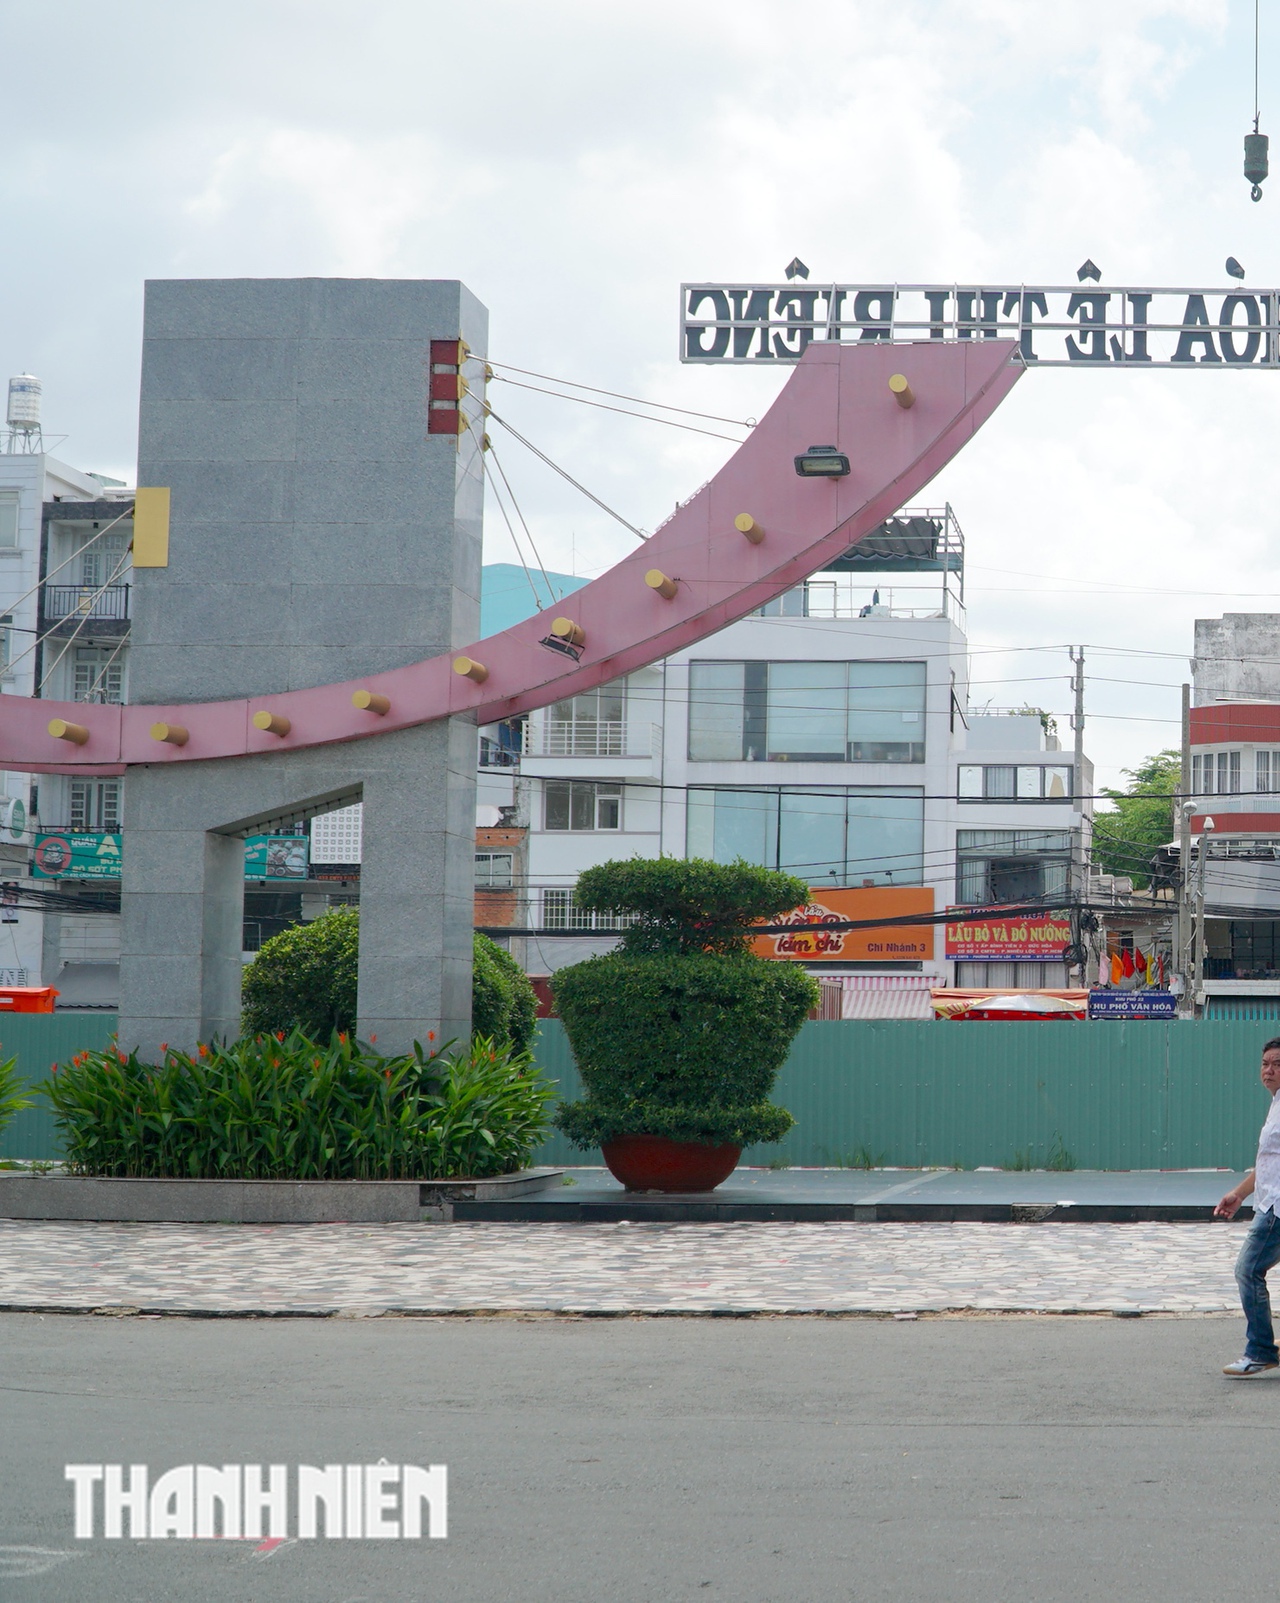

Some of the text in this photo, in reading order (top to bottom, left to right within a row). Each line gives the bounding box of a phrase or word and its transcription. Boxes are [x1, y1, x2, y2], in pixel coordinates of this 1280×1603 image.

[974, 923, 990, 942] BÒ
[992, 923, 1009, 942] VÀ
[1011, 921, 1028, 942] ĐỒ
[777, 933, 842, 952] kim chi
[867, 942, 926, 952] Chi Nhánh 3
[1109, 1001, 1129, 1010] PHỐ
[1152, 1001, 1172, 1010] HÓA
